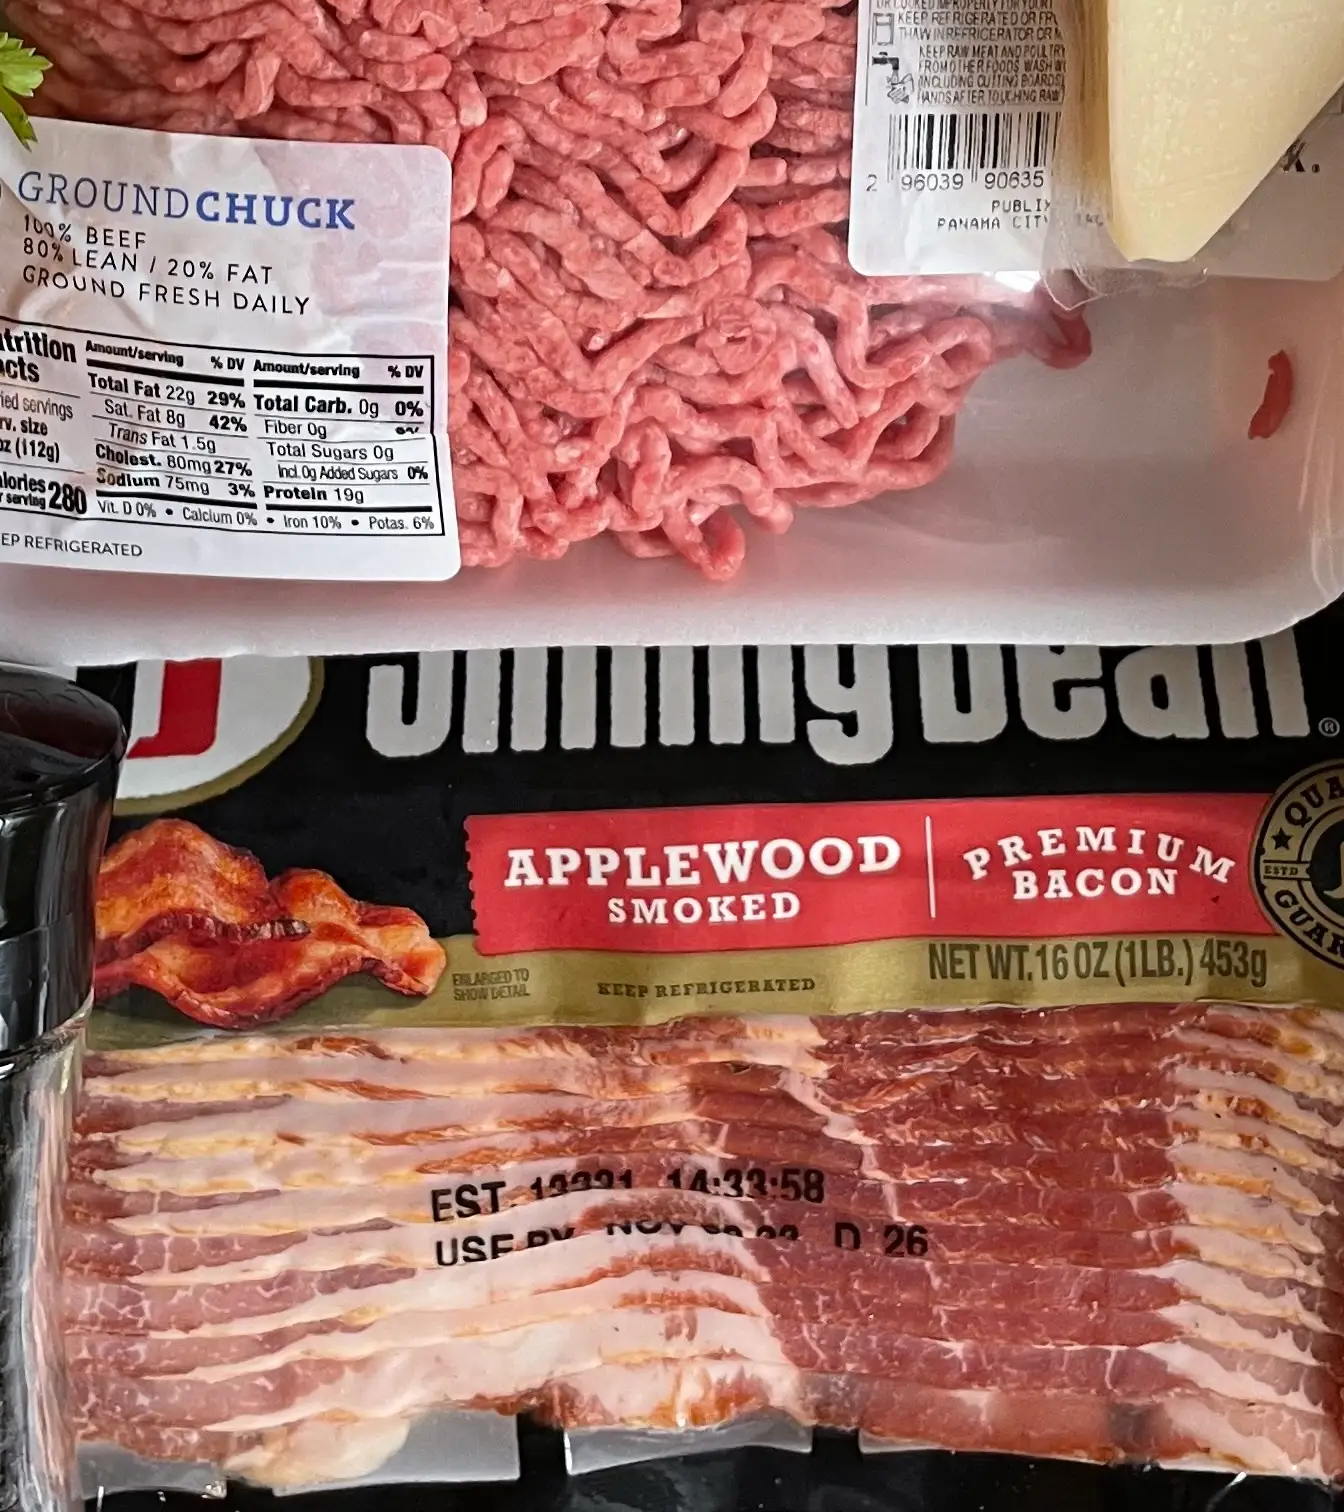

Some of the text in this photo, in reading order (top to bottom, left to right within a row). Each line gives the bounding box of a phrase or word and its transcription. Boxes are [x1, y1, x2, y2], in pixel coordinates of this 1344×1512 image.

[901, 169, 1045, 192] 96039 90635
[23, 213, 147, 250] 100% BEEF
[936, 216, 1002, 231] PANAMA
[22, 236, 274, 286] 80% LEAN 20% FAT
[22, 264, 312, 317] GROUND FRESH DAILY
[85, 339, 185, 368] Amount/serving
[253, 358, 361, 379] Amount/serving
[87, 371, 247, 410] Total Fat 22g 29%
[253, 393, 353, 415] Total Carb.
[22, 394, 75, 420] servings
[136, 404, 249, 433] Fat 42%
[108, 421, 218, 454] Trans Fat 1.5g
[263, 418, 303, 436] Fiber
[94, 442, 254, 478] Cholest. 80mg 27%
[266, 440, 368, 461] Total Sugars
[95, 467, 256, 498] Sodium 75mg 3%
[319, 465, 399, 483] Added Sugars
[47, 480, 88, 516] 280
[262, 485, 365, 505] Protein 19g
[181, 506, 309, 529] Calcium Iron
[23, 534, 144, 558] REFRIGERATED
[503, 833, 902, 889] APPLEWOOD
[962, 825, 1236, 884] PREMIUM
[1011, 867, 1179, 901] BACON
[607, 890, 802, 926] SMOKED
[928, 936, 1268, 988] NET WT. 16 OZ 453g
[452, 970, 513, 987] ENLARGED
[596, 977, 817, 999] KEEP REFRIGERATED
[453, 986, 489, 1002] SHOW
[883, 1223, 930, 1258] 26
